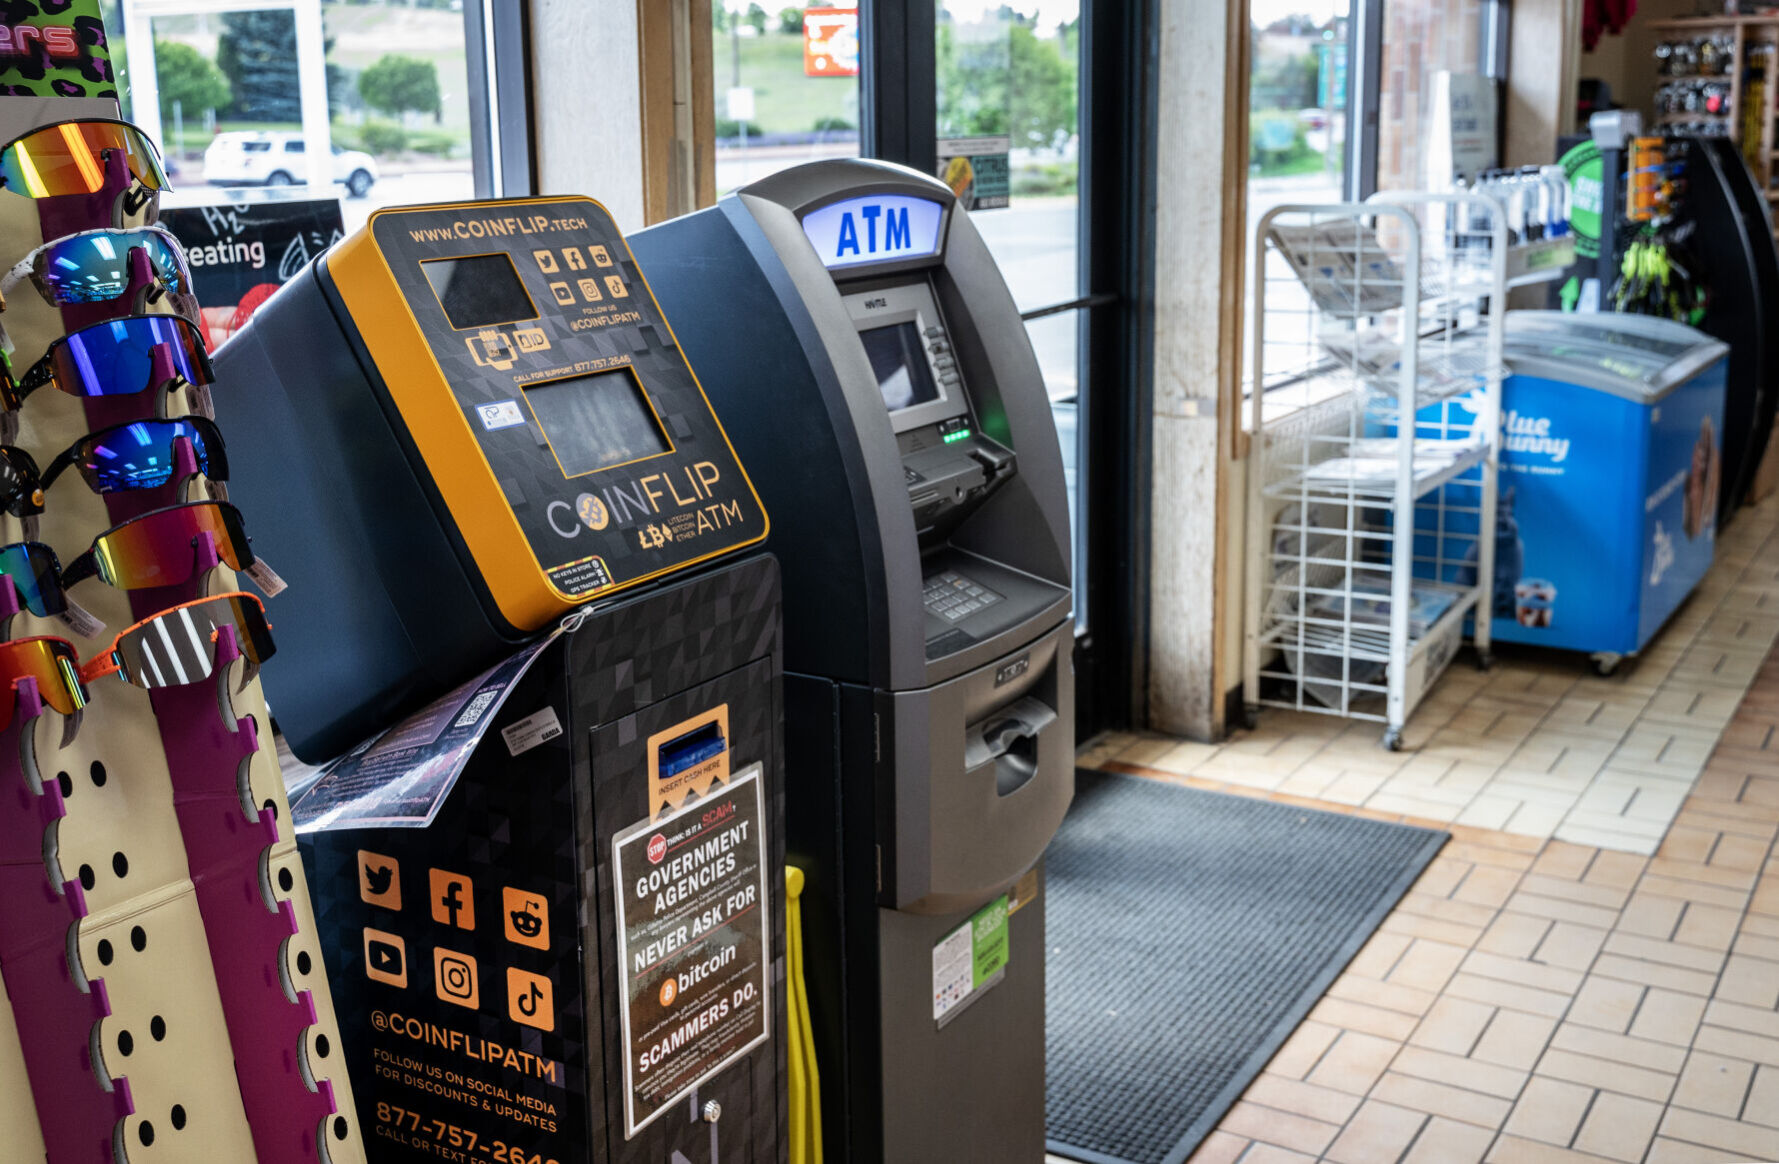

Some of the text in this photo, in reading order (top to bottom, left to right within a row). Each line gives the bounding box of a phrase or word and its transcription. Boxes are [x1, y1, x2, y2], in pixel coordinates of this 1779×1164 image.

[836, 204, 912, 258] ATM
[570, 311, 641, 332] @COINFLIPATM
[582, 304, 618, 316] FOLLOW US
[513, 374, 531, 383] CALL
[531, 371, 545, 379] FOR
[547, 460, 721, 539] COINFLIP
[696, 498, 744, 536] ATM
[658, 759, 721, 796] INSERT CASH HERE
[636, 820, 749, 899] GOVERNMENT
[649, 840, 665, 857] STOP
[654, 852, 736, 915] AGENCIES
[634, 925, 687, 972] NEVER
[691, 904, 723, 938] ASK
[727, 884, 756, 917] FOR
[678, 944, 737, 994] bitcoin
[371, 1010, 556, 1083] @COINFLIPATM
[639, 998, 729, 1073] SCAMMERS
[732, 982, 758, 1009] DO.
[373, 1048, 557, 1116] FOLLOW US ON SOCIAL MEDIA
[375, 1064, 558, 1133] FOR DISCOUNTS & UPDATES
[376, 1101, 560, 1164] 877-757-26
[376, 1125, 466, 1164] CALL OR TEXT
